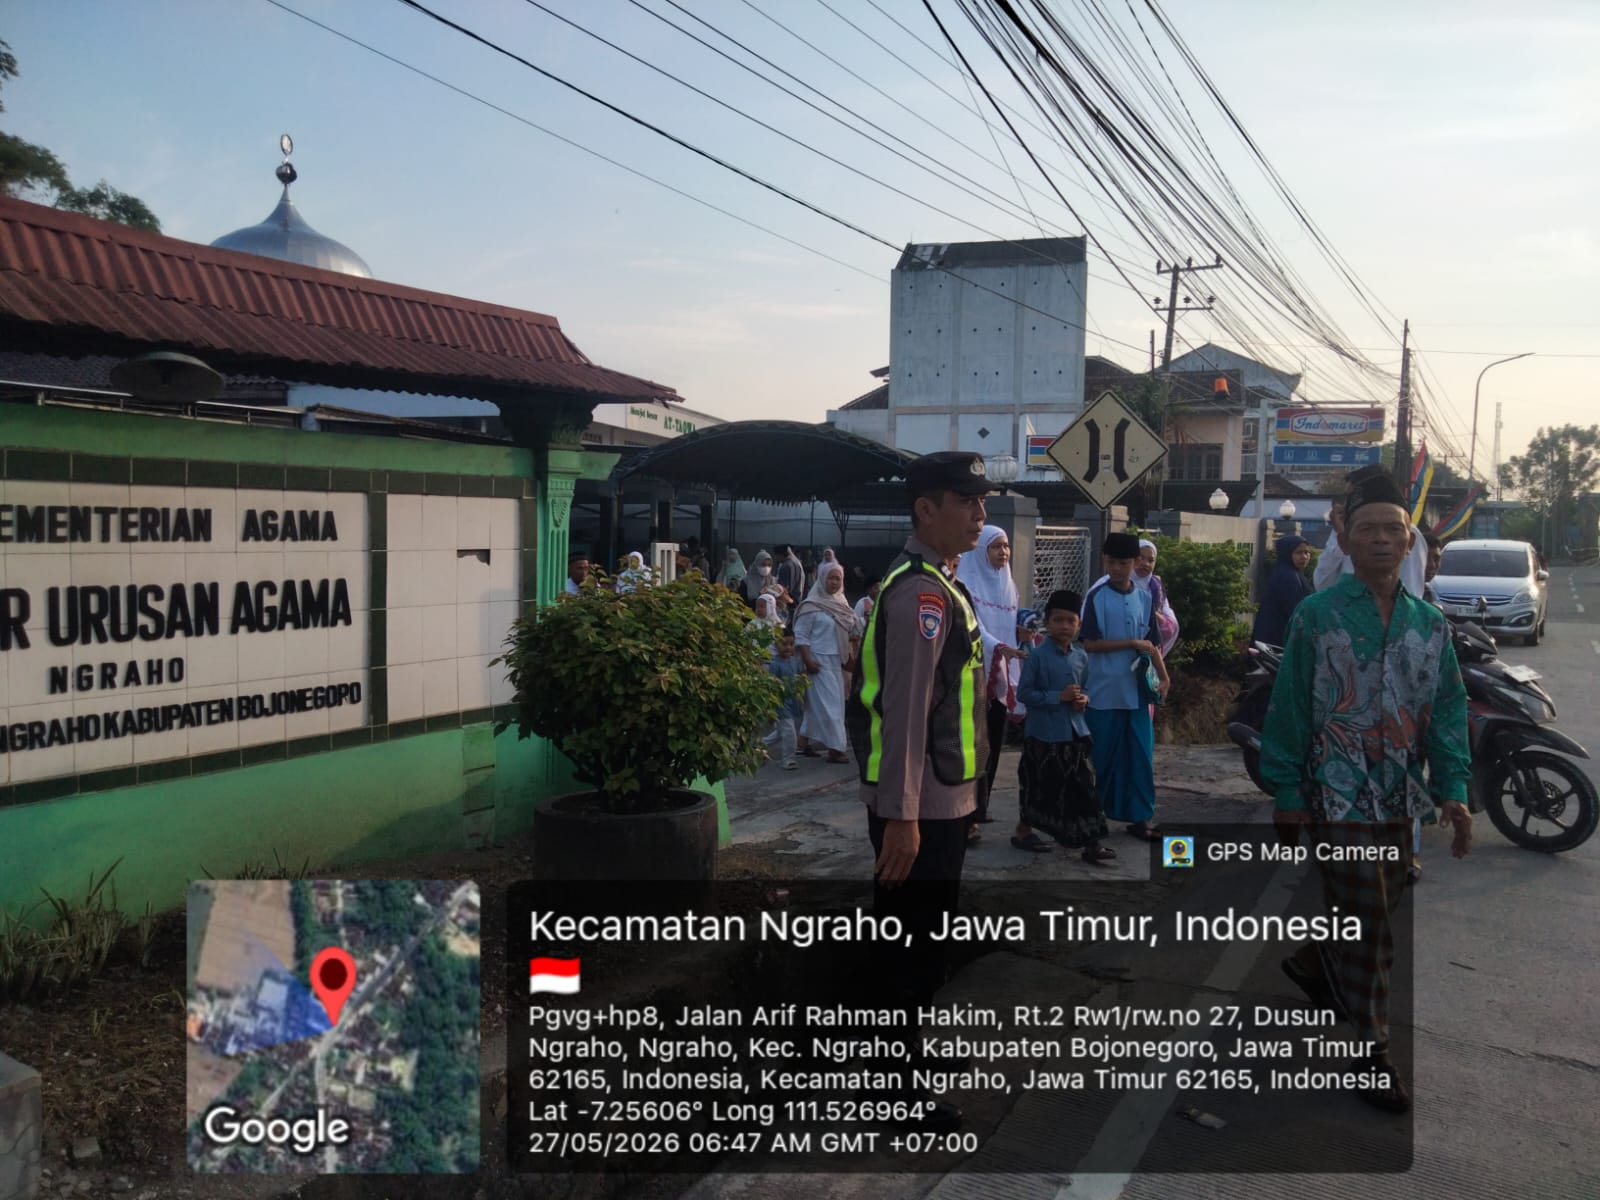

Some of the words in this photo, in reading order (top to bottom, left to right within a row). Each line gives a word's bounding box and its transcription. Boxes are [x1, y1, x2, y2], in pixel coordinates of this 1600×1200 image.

[1294, 417, 1364, 430] Indomaret
[242, 508, 338, 542] AGAMA
[47, 582, 219, 647] URUSAN
[230, 577, 352, 635] AGAMA
[48, 656, 184, 695] NGRAHO
[103, 697, 234, 740] KABUPATEN
